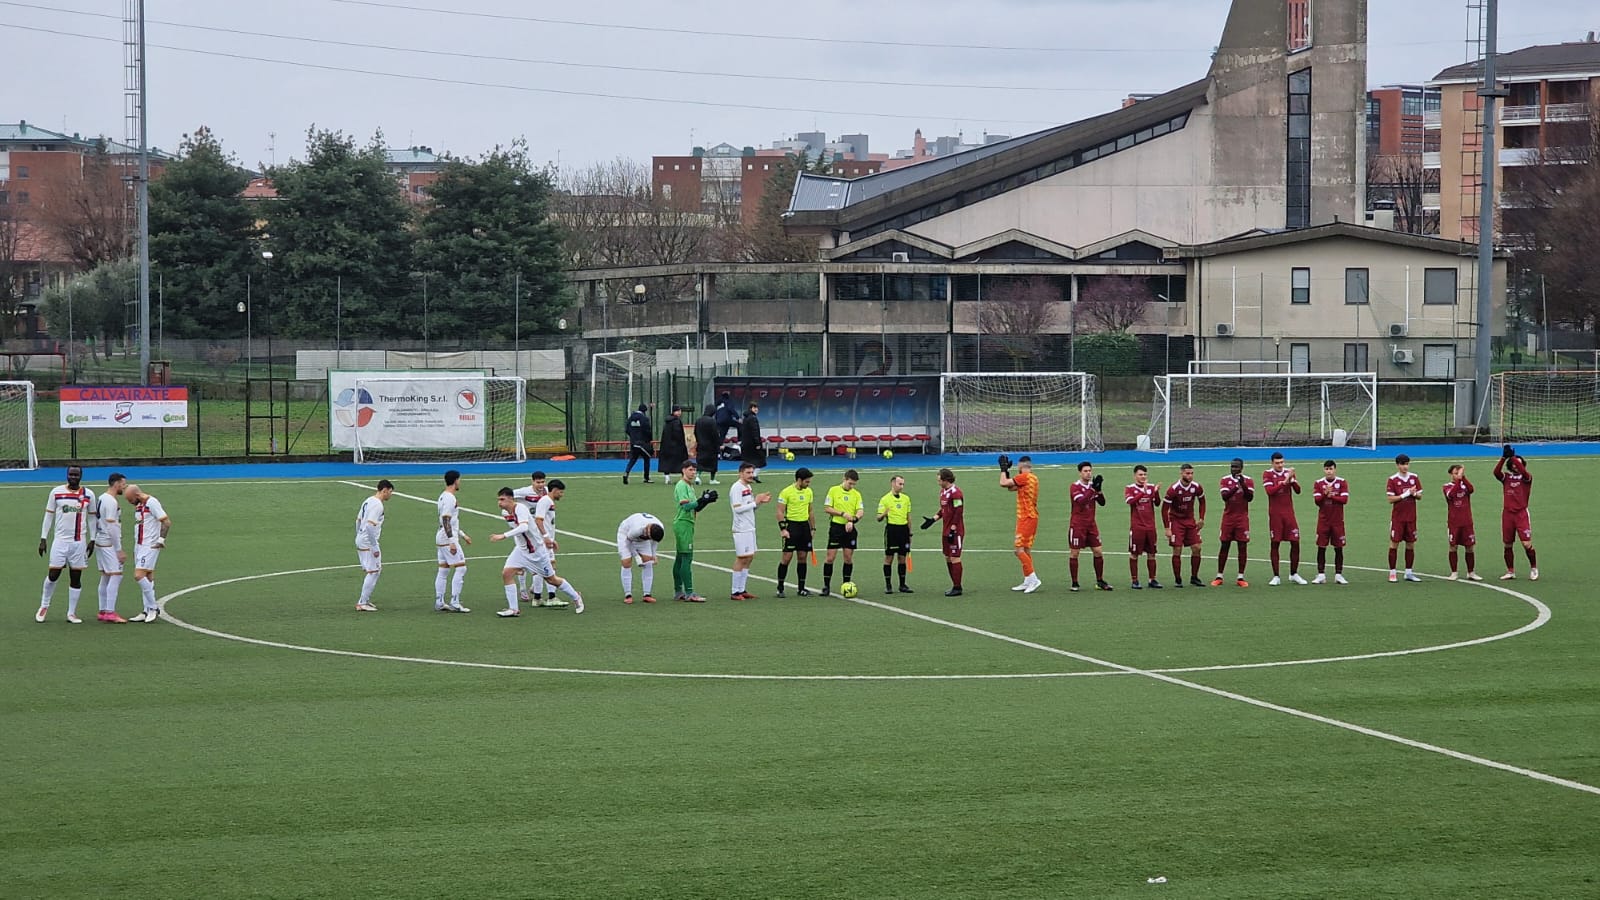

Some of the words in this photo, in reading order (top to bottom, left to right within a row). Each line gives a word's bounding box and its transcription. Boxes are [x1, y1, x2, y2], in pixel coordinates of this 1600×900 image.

[80, 389, 169, 401] CALVAIRATE
[380, 395, 429, 404] ThermoKing
[430, 395, 448, 403] S.r.l.
